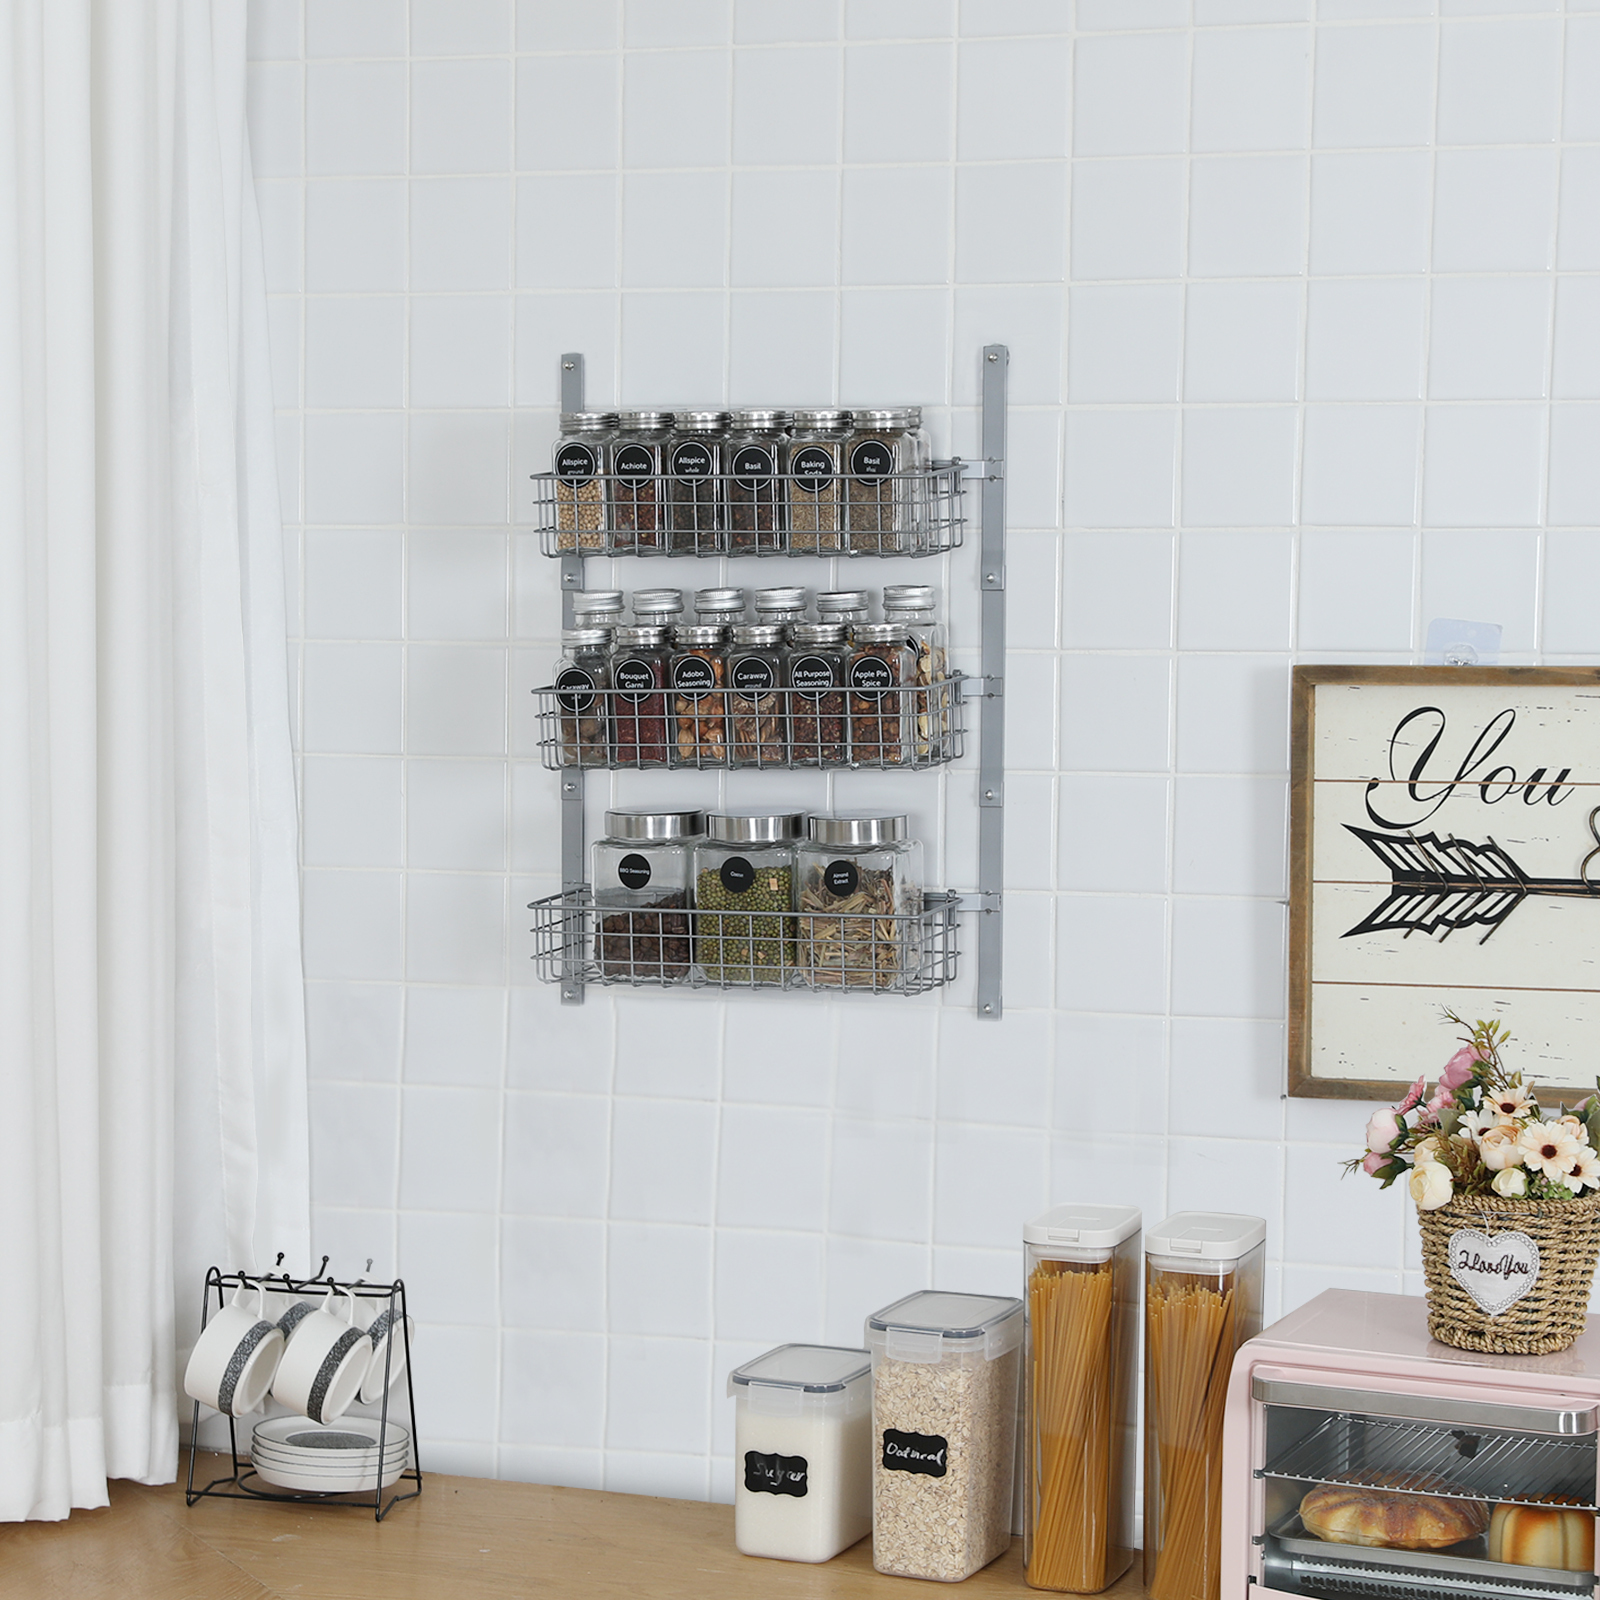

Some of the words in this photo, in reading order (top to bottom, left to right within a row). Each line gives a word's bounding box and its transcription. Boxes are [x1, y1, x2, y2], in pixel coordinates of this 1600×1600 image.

[562, 458, 588, 466] Allspice
[678, 456, 706, 465] Allspice
[863, 456, 880, 465] Basil
[621, 462, 647, 470] Achiote
[744, 462, 762, 470] Basil
[801, 461, 825, 470] Baking
[620, 672, 649, 681] Bouquet
[737, 672, 768, 681] Caraway
[803, 670, 830, 678] Purpose
[854, 671, 875, 679] Apple
[876, 670, 888, 678] Pie
[625, 681, 644, 689] Garni
[677, 680, 711, 688] Seasoning
[796, 680, 830, 688] Seasoning
[861, 680, 882, 688] Spice
[1364, 706, 1576, 830] You
